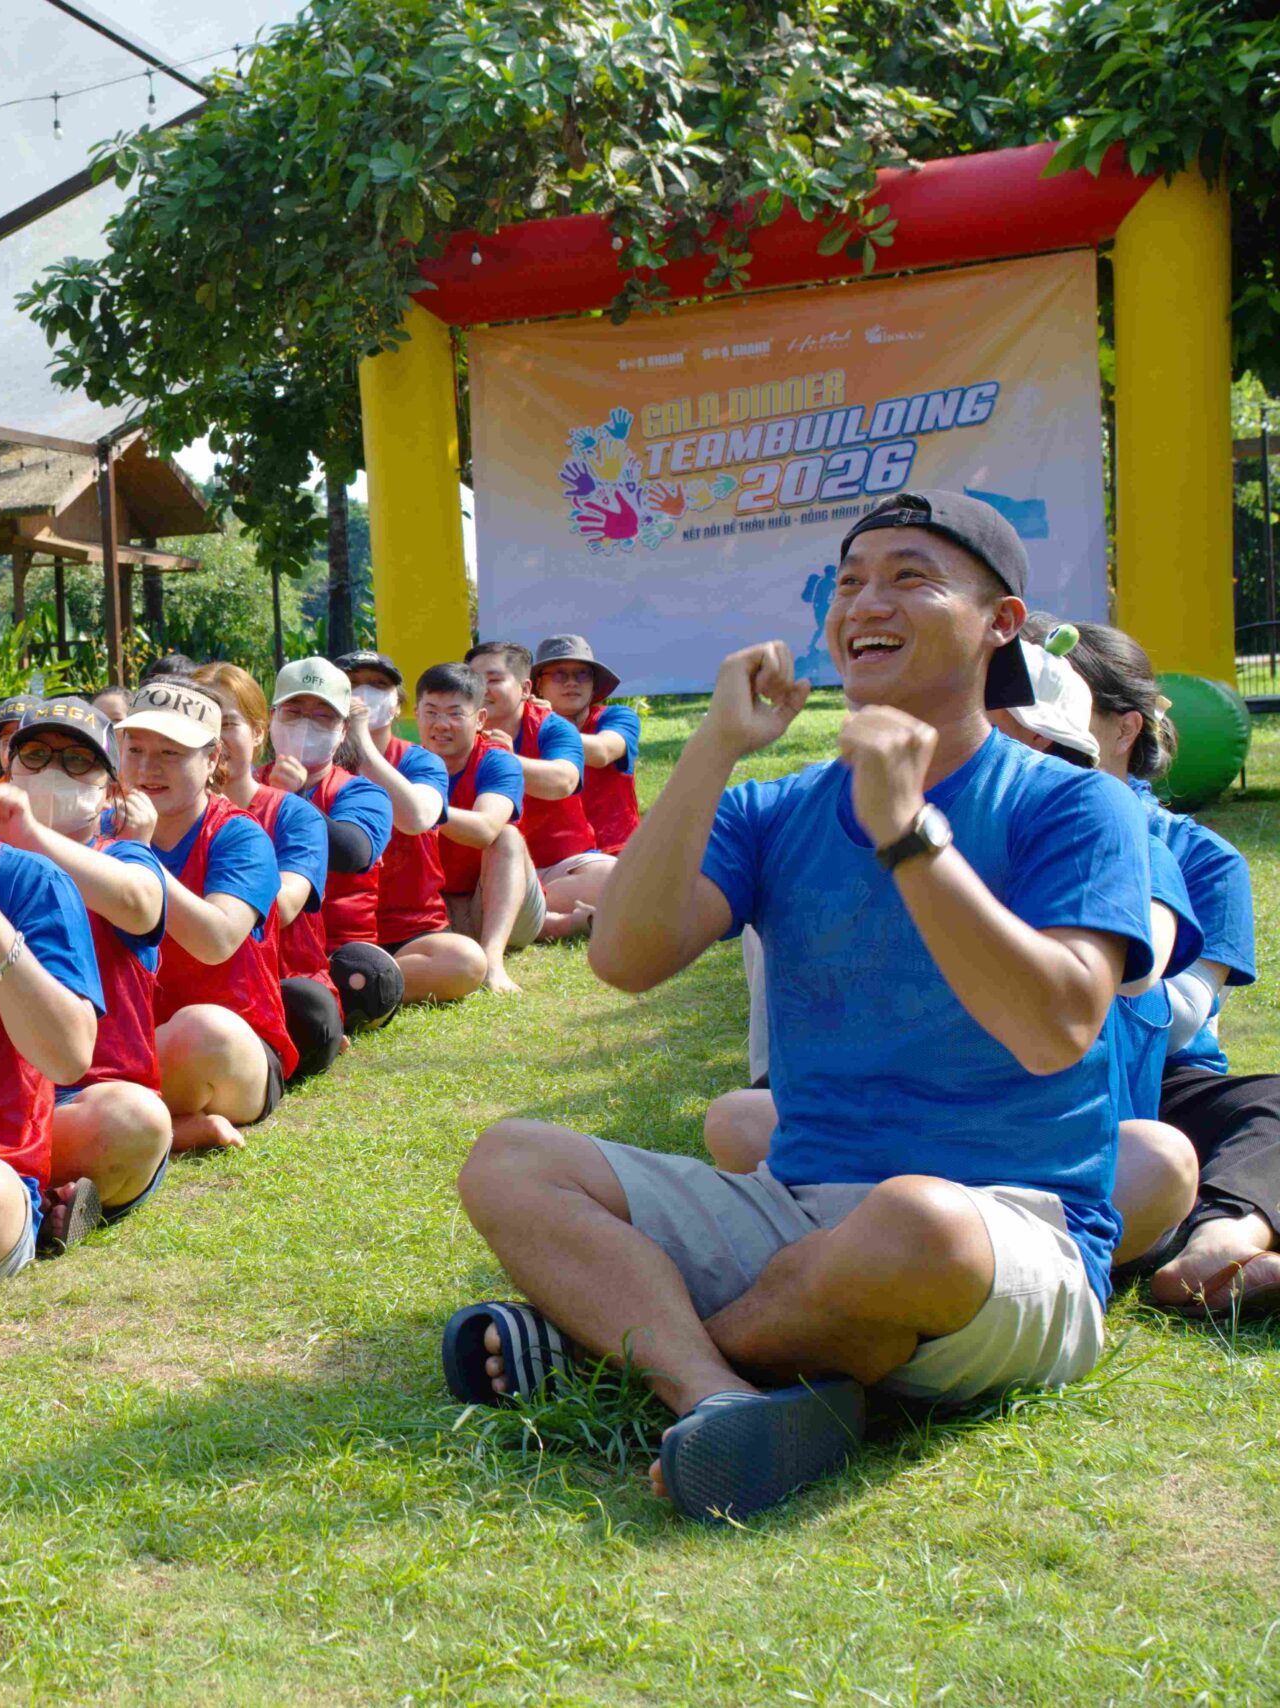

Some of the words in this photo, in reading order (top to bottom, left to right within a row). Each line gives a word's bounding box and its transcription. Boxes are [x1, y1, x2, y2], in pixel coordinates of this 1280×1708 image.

[640, 393, 719, 438] GALA
[728, 369, 846, 423] DINNER
[643, 381, 1001, 479] TEAMBUILDING
[734, 440, 917, 515] 2026
[130, 689, 213, 722] PORT
[302, 674, 325, 686] OFF
[34, 704, 97, 729] MEGA
